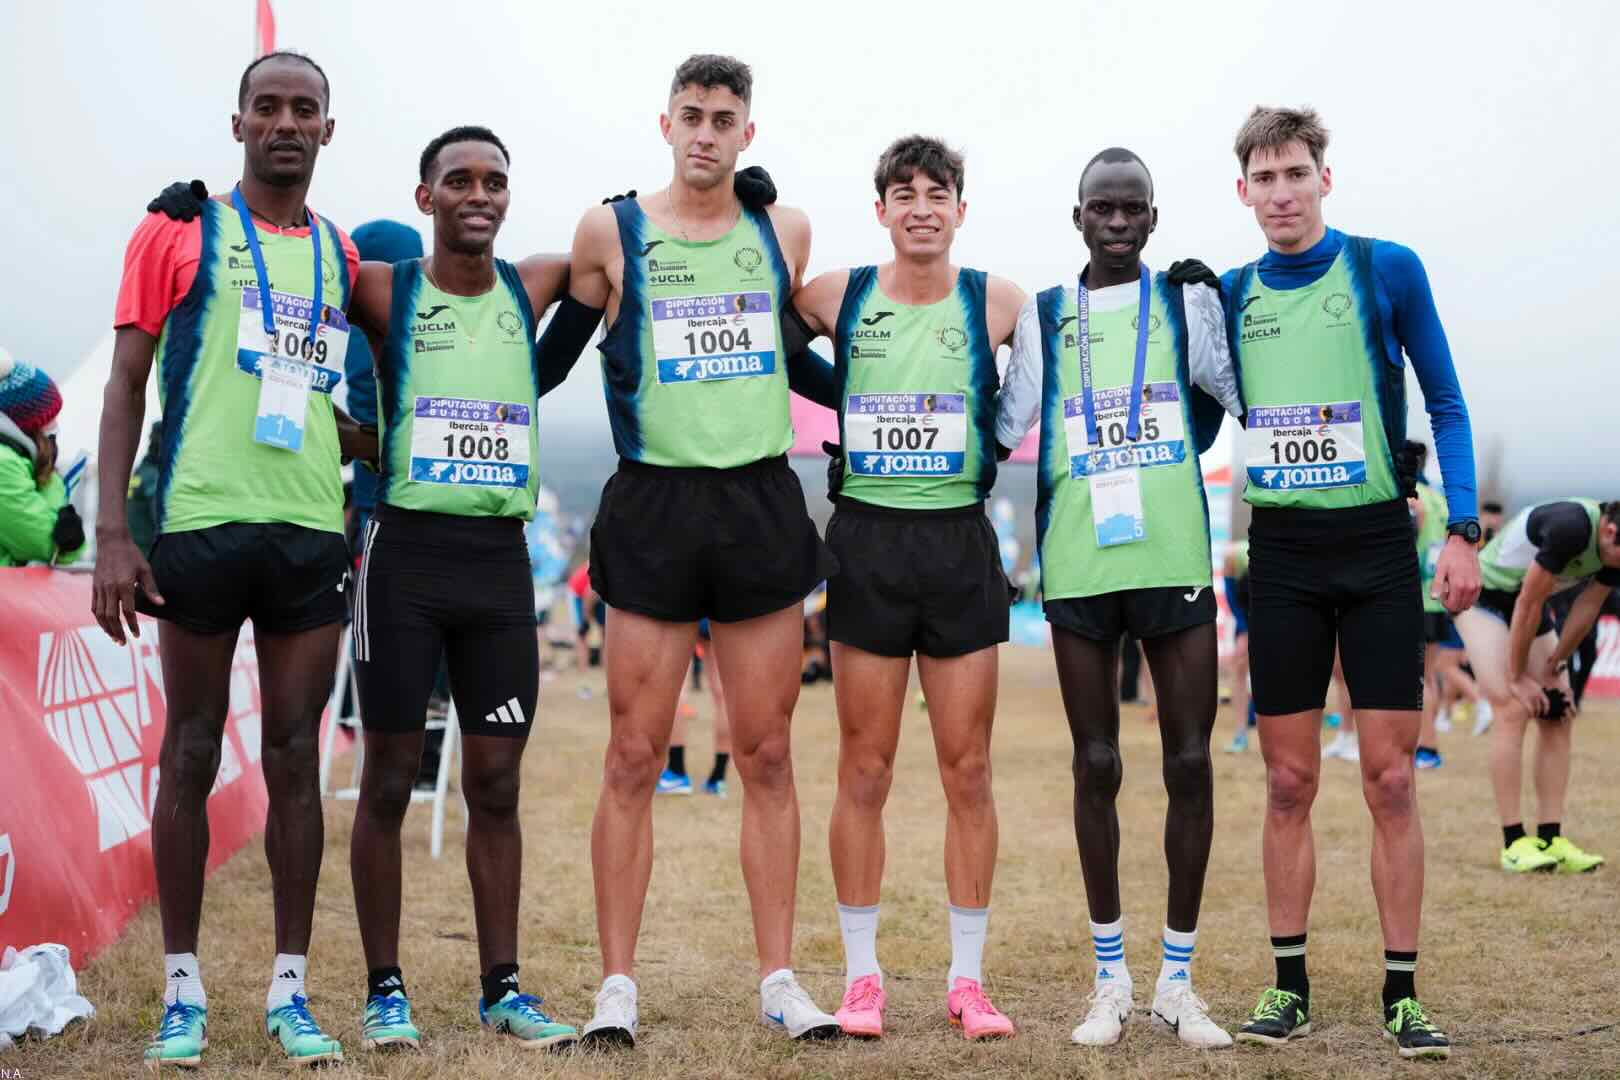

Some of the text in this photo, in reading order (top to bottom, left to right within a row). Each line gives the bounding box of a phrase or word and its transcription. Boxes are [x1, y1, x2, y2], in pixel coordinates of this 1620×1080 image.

[658, 274, 695, 284] UCLM
[665, 306, 727, 318] BURGOS
[687, 317, 727, 328] Ibercaja
[855, 330, 891, 338] UCLM
[1247, 327, 1281, 339] UCLM
[684, 328, 752, 355] 1004
[696, 355, 763, 378] Joma
[429, 408, 489, 419] BURGOS
[859, 404, 917, 413] BURGOS
[1095, 408, 1130, 421] Ibercaj
[877, 415, 917, 425] Ibercaja
[449, 421, 489, 433] Ibercaja
[1273, 428, 1312, 438] Ibercaja
[872, 427, 939, 450] 1007
[443, 434, 509, 461] 1008
[1270, 439, 1338, 464] 1006
[880, 455, 950, 474] Joma
[449, 464, 516, 482] Joma
[1280, 465, 1350, 488] Joma
